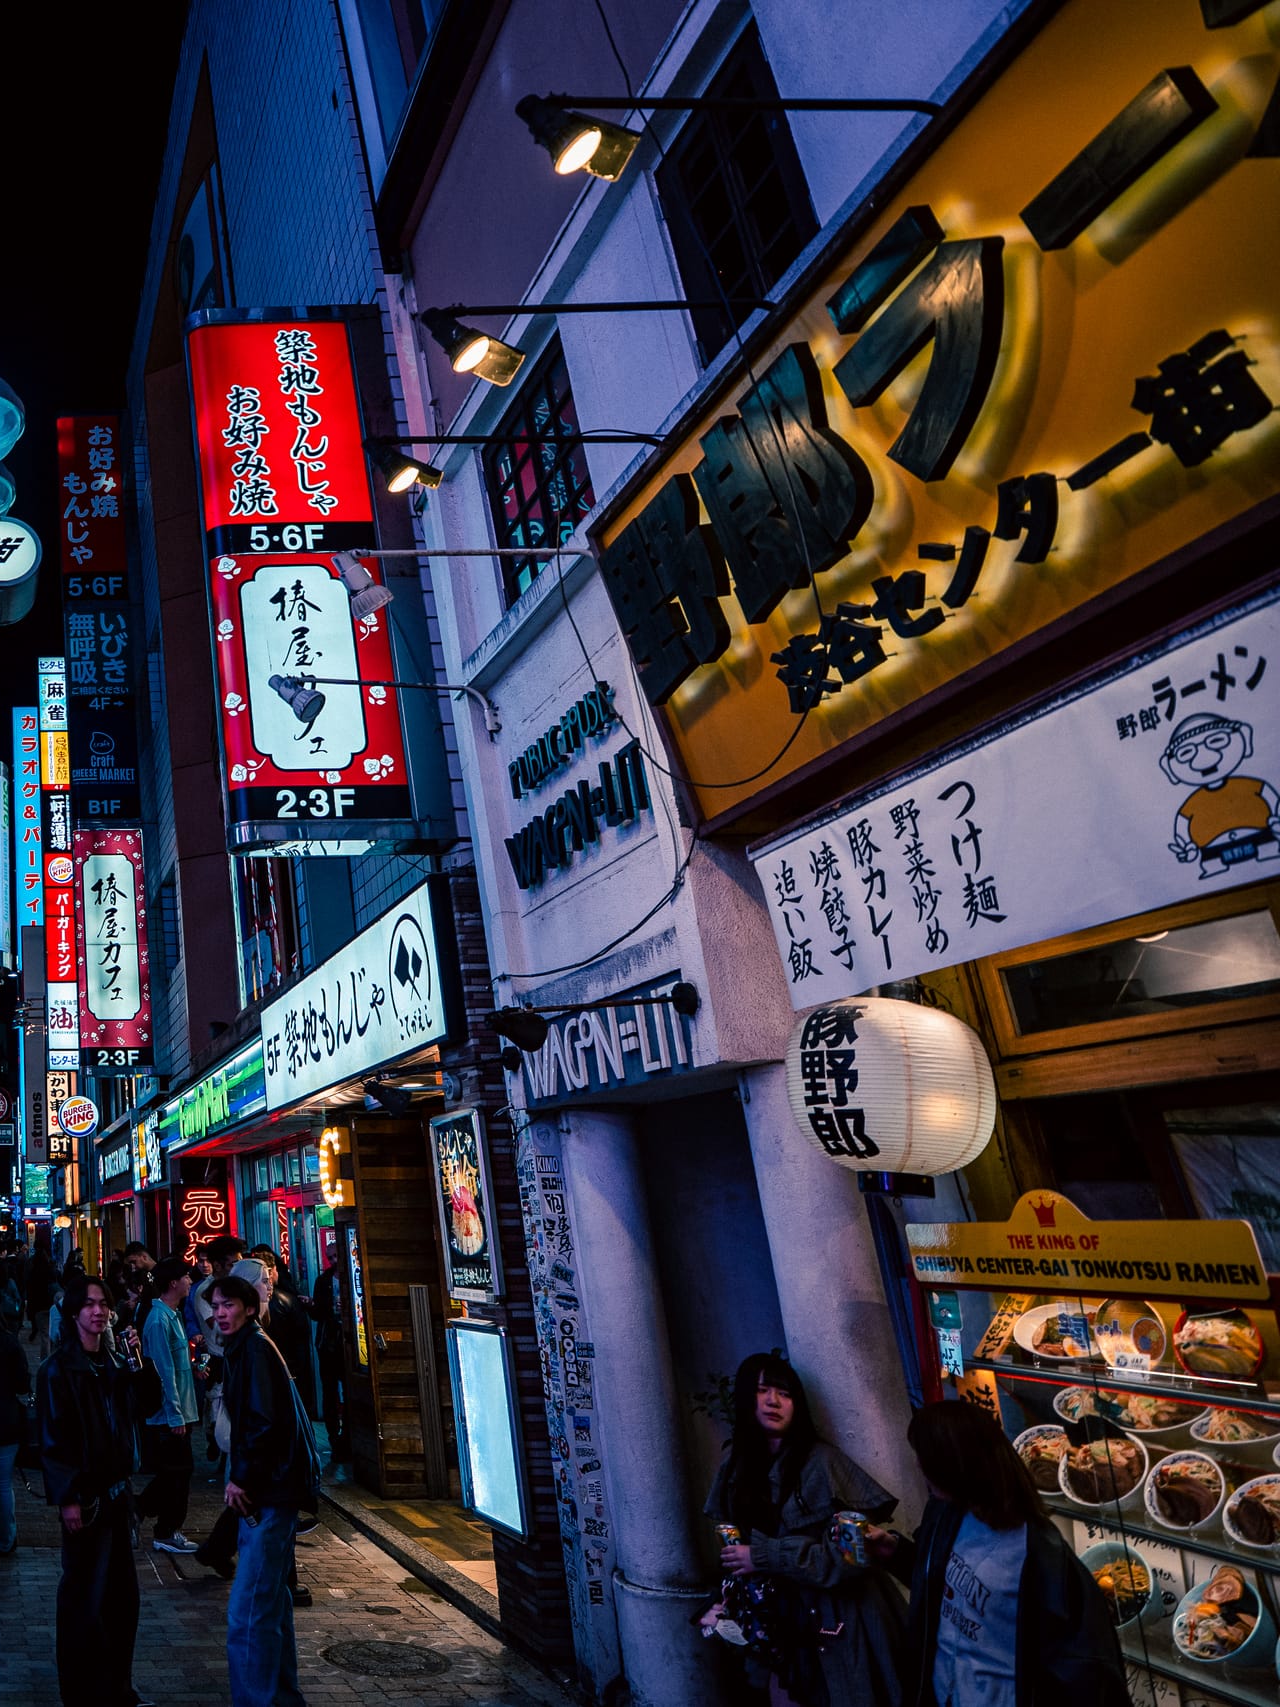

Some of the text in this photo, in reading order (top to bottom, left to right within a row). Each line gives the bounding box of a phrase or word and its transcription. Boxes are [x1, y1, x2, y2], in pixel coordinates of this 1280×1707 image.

[597, 0, 1280, 706] 野郎ラー
[222, 385, 279, 517] お好み焼
[274, 329, 338, 515] 築地もんじゃ
[87, 425, 119, 518] お好み焼
[63, 472, 93, 565] もんじゃ
[771, 329, 1272, 714] 渋谷センター街
[39, 660, 64, 670] センタービ
[68, 612, 99, 684] 無呼吸
[99, 612, 129, 684] いびき
[269, 579, 328, 754] 椿屋ェ
[47, 682, 65, 721] 麻雀
[88, 697, 111, 711] 4F
[1115, 645, 1267, 740] 野郎ラーメン
[90, 755, 115, 767] Craft
[99, 768, 135, 781] MARKET
[508, 681, 616, 799] PUBLIC HOUSE
[88, 800, 121, 814] B1F
[847, 818, 893, 970] 豚カレー
[888, 798, 950, 956] 野菜炒め
[937, 780, 1007, 929] つけ麺
[56, 894, 71, 977] バーガーキング
[91, 873, 128, 1000] 椿屋カフェ
[774, 859, 824, 984] 追い飯
[809, 841, 857, 972] 焼餃子
[51, 1055, 79, 1065] センタービ
[266, 1033, 281, 1076] 5F
[284, 967, 385, 1080] 築地もんじゃ
[63, 1103, 92, 1118] BURGER
[64, 1110, 94, 1127] KING
[178, 1069, 230, 1140] FamilyMart
[800, 1004, 881, 1159] 豚野郎
[536, 1155, 559, 1173] KIMO
[915, 1255, 1260, 1286] SHIBUYA CENTER-GAI TONKOTSU RAMEN
[1007, 1234, 1100, 1251] THE KING OF
[594, 1480, 603, 1502] VEGAN
